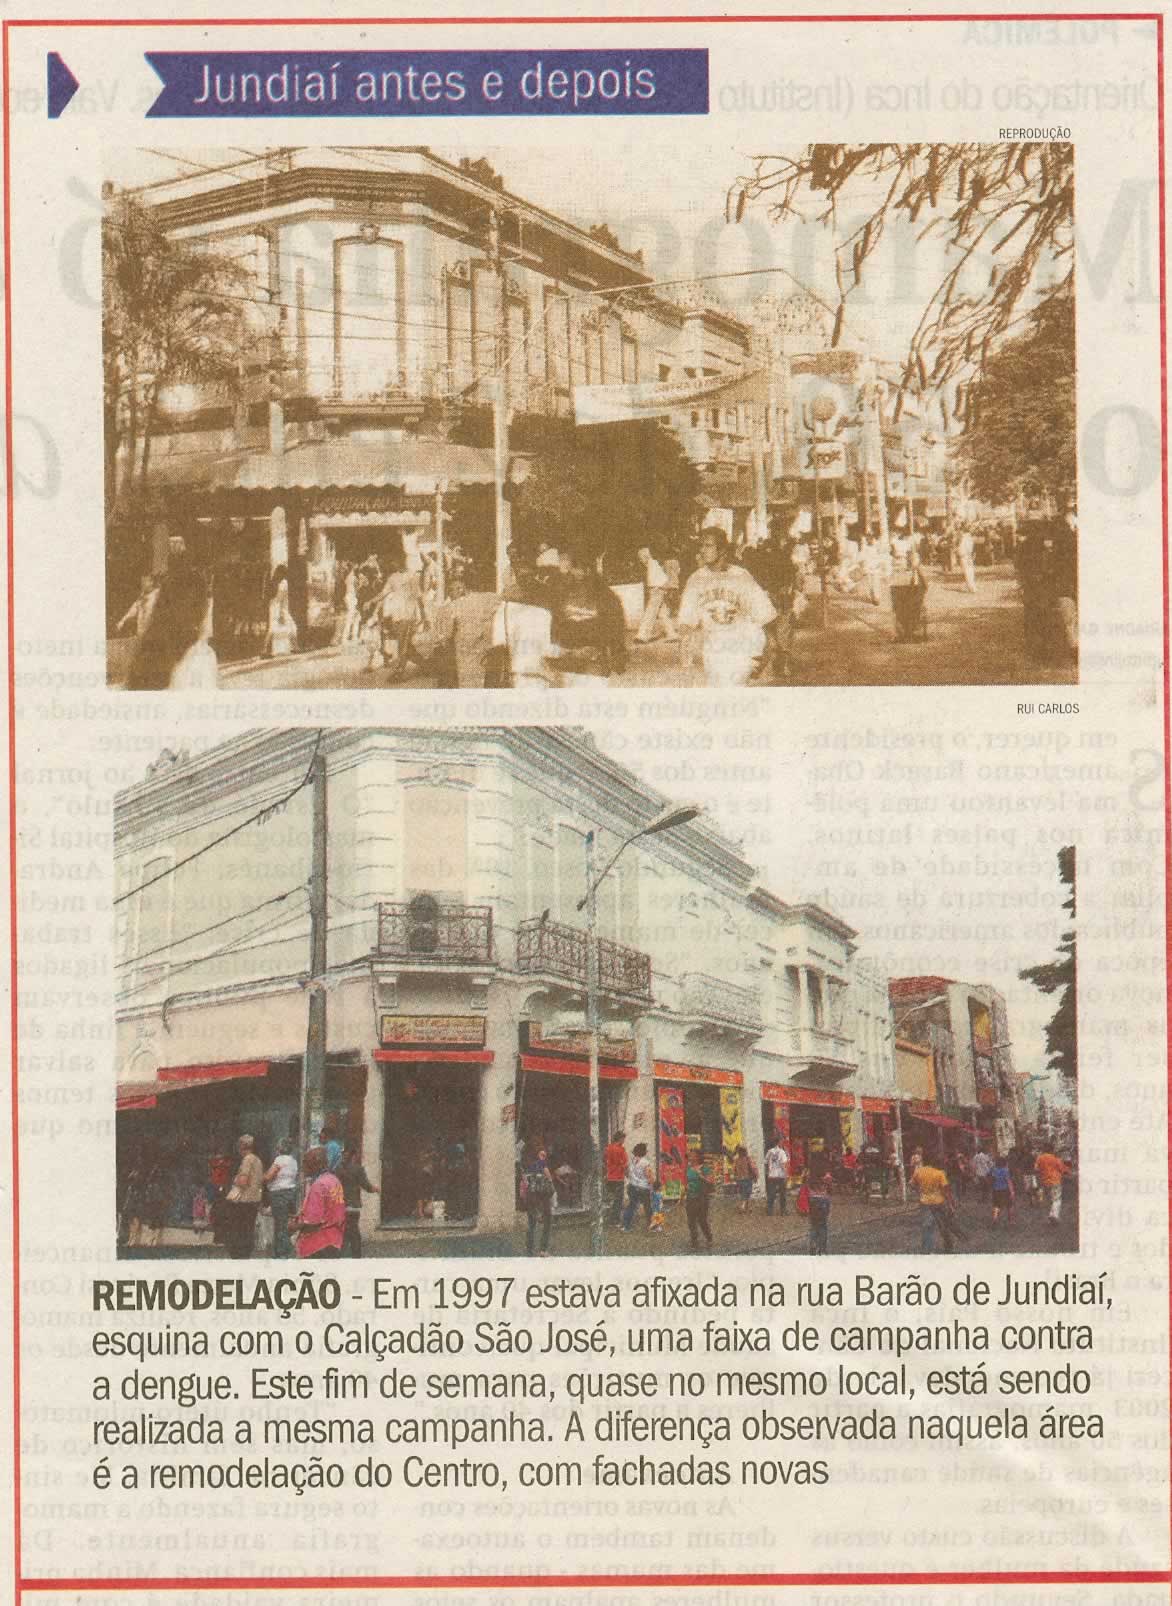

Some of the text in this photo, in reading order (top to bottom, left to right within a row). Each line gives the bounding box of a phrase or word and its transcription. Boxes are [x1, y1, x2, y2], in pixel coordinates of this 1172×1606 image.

[193, 62, 340, 102] Jundiaí
[356, 66, 466, 101] antes
[482, 71, 503, 100] e
[521, 60, 656, 107] depois
[999, 125, 1071, 141] REPRODUÇÃO
[1017, 703, 1080, 714] RUI CARLOS
[92, 1272, 341, 1320] REMODELAÇÃO
[374, 1278, 419, 1309] Em
[433, 1277, 515, 1309] 1997
[525, 1279, 621, 1309] estava
[632, 1275, 738, 1308] afixada
[750, 1282, 785, 1307] na
[797, 1282, 843, 1307] rua
[855, 1274, 942, 1307] Barão
[952, 1274, 991, 1306] de
[997, 1271, 1113, 1310] Jundiaí,
[92, 1319, 1093, 1363] esquina com o Calçadão São José, uma faixa de campanha contra
[92, 1361, 1091, 1408] a dengue. Este fim de semana, quase no mesmo local, está sendo
[93, 1405, 1104, 1450] realizada a mesma campanha. A diferença observada naquela área
[93, 1454, 829, 1496] é a remodelação do Centro, com fachadas novas
